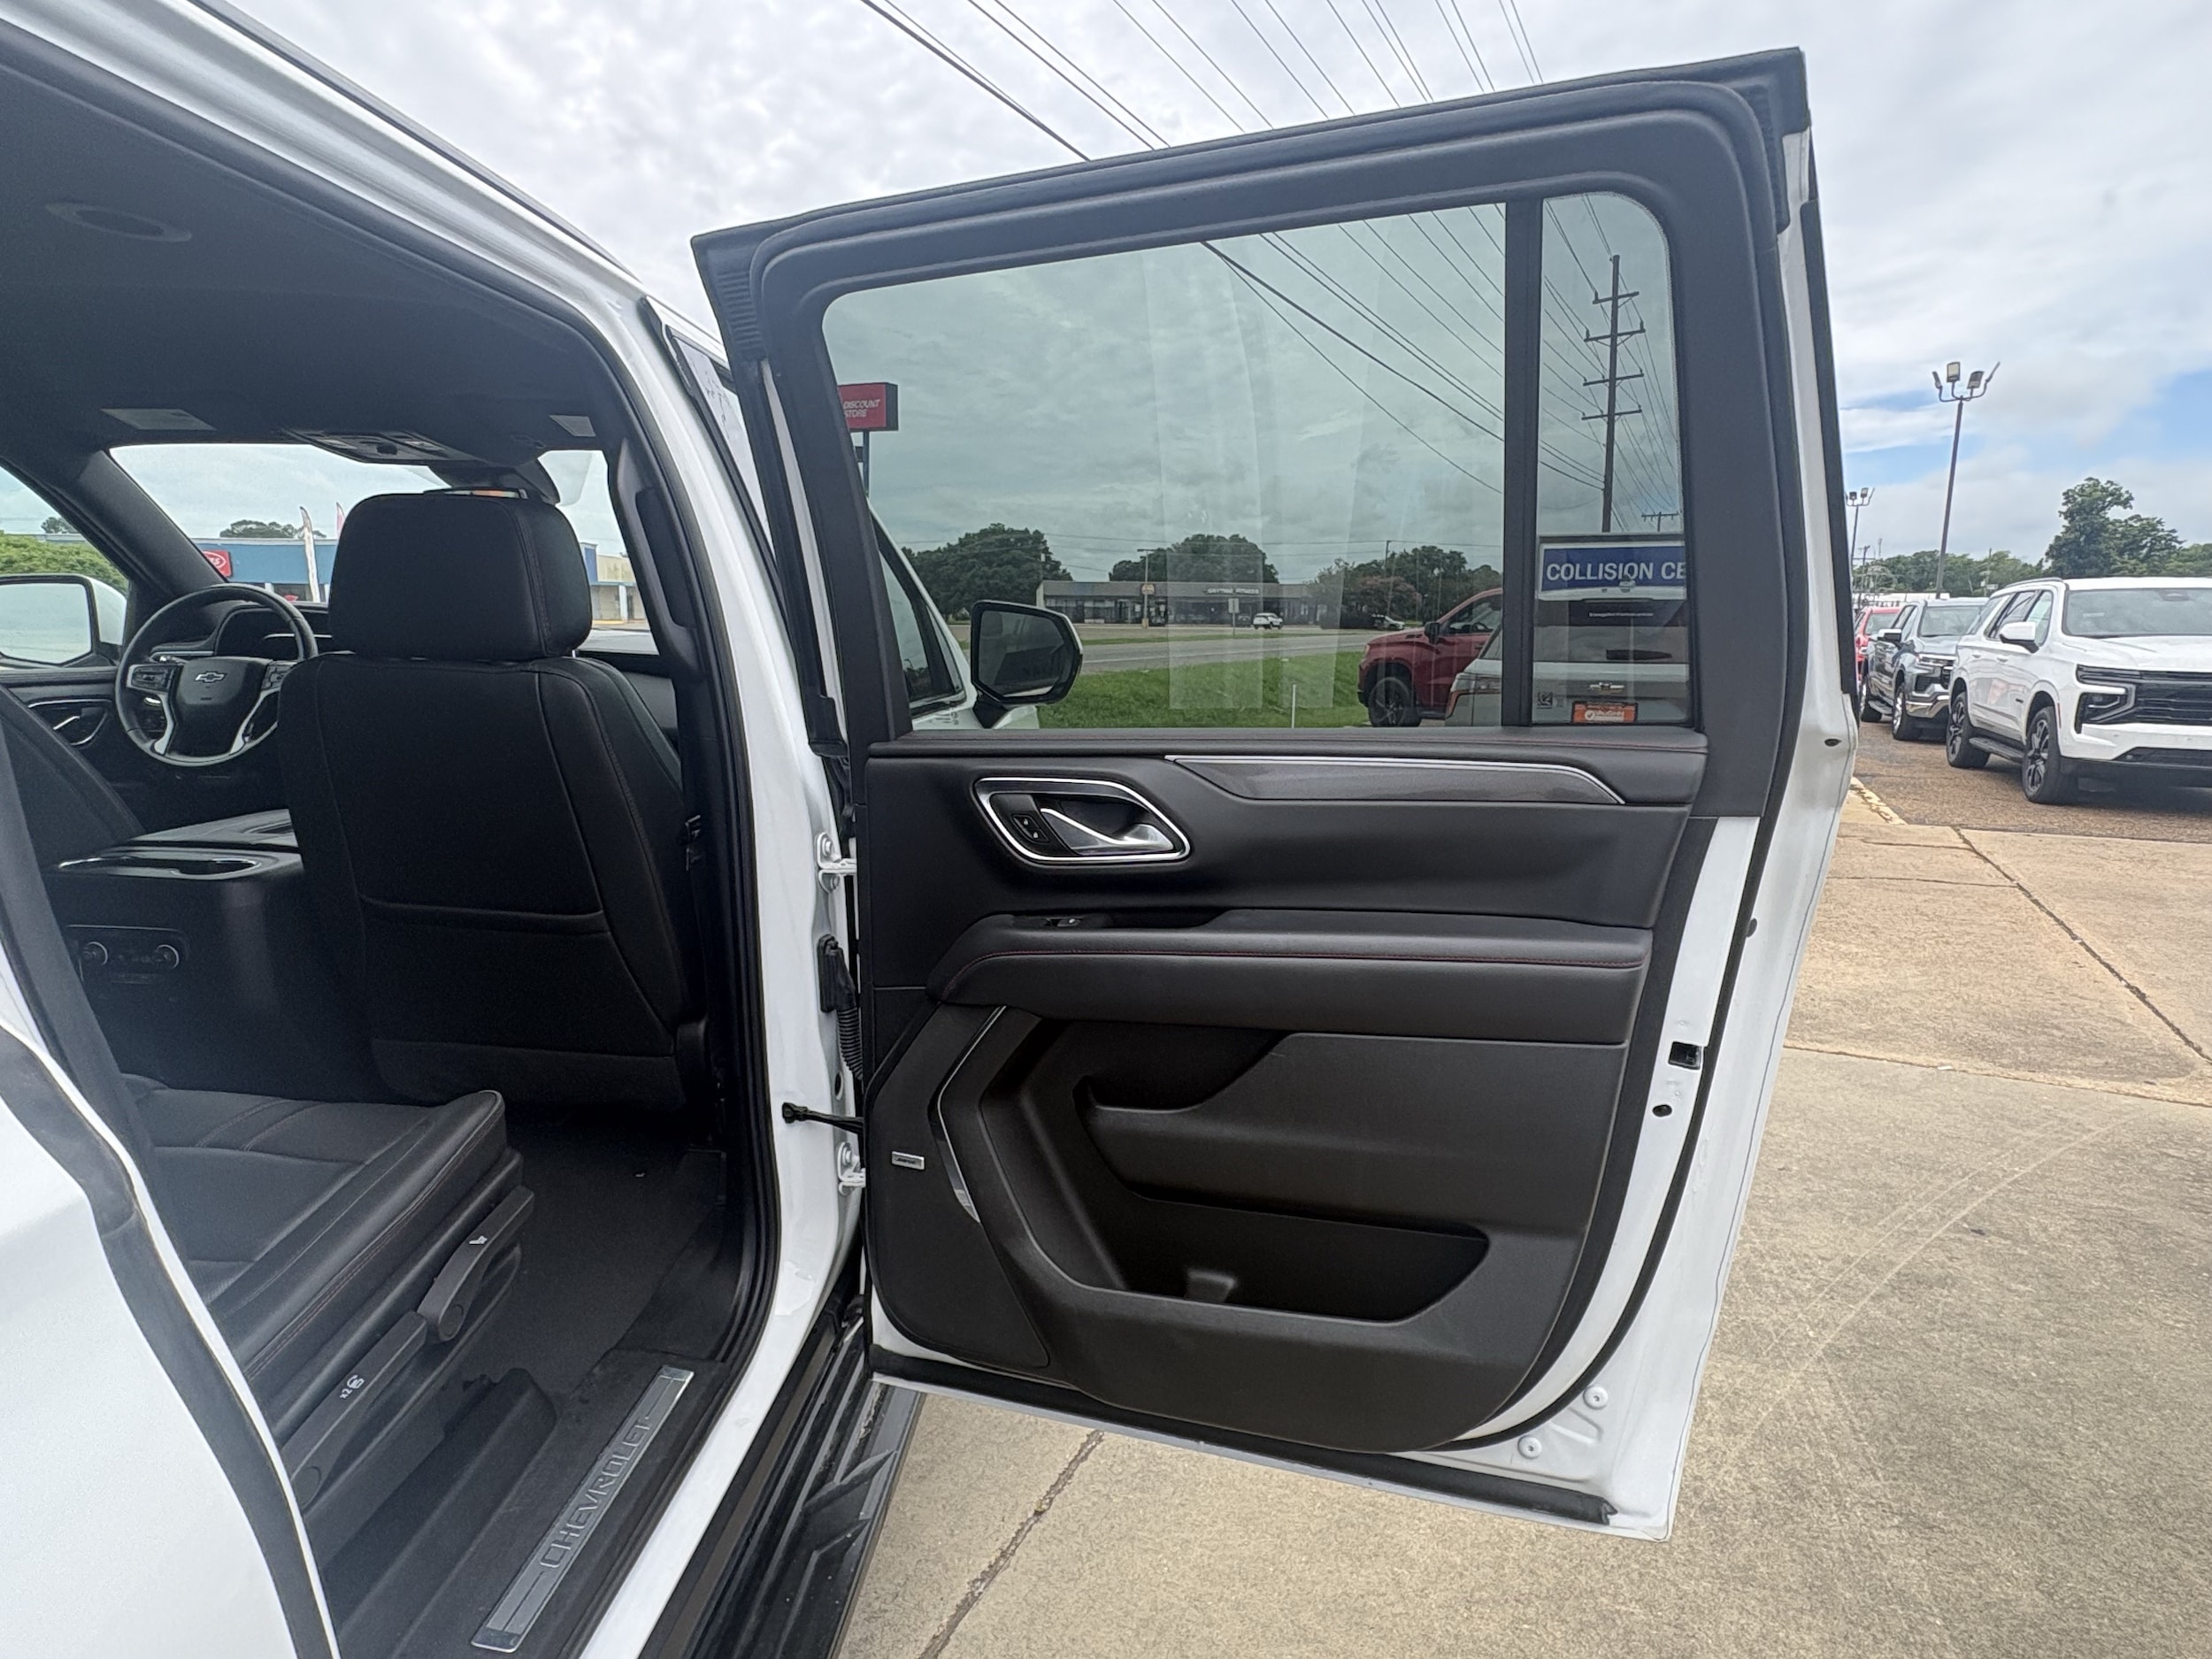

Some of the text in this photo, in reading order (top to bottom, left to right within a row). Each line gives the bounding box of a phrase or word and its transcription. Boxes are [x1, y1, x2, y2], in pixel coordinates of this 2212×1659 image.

[843, 399, 880, 410] DISCOUNT
[844, 409, 868, 419] STORE
[1547, 562, 1654, 581] COLLISION
[540, 1416, 651, 1570] CHEVROLET
